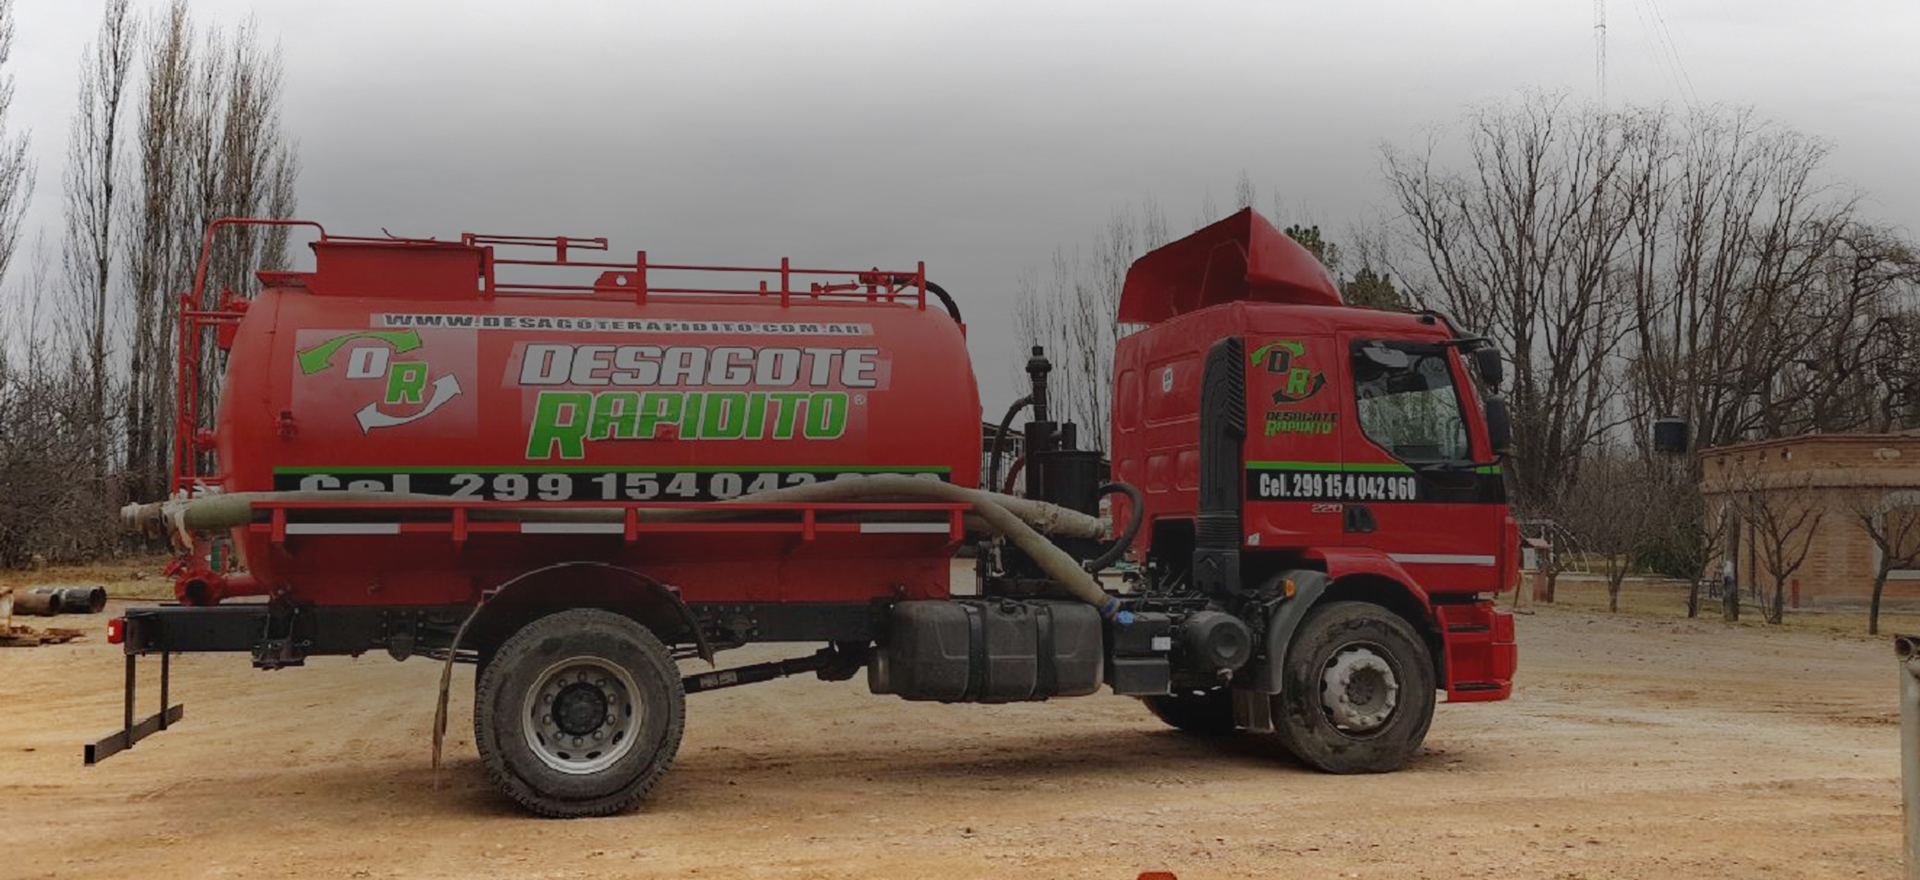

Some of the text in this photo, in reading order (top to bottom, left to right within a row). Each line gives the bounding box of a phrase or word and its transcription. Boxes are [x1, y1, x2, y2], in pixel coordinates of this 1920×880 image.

[518, 343, 880, 388] DESAGOTE
[524, 391, 850, 459] RAPIDITO
[449, 474, 573, 501] 299
[591, 473, 700, 500] 154
[1259, 473, 1291, 497] Cel.
[1293, 473, 1323, 498] 299
[1357, 475, 1386, 500] 042
[1311, 503, 1344, 513] 220
